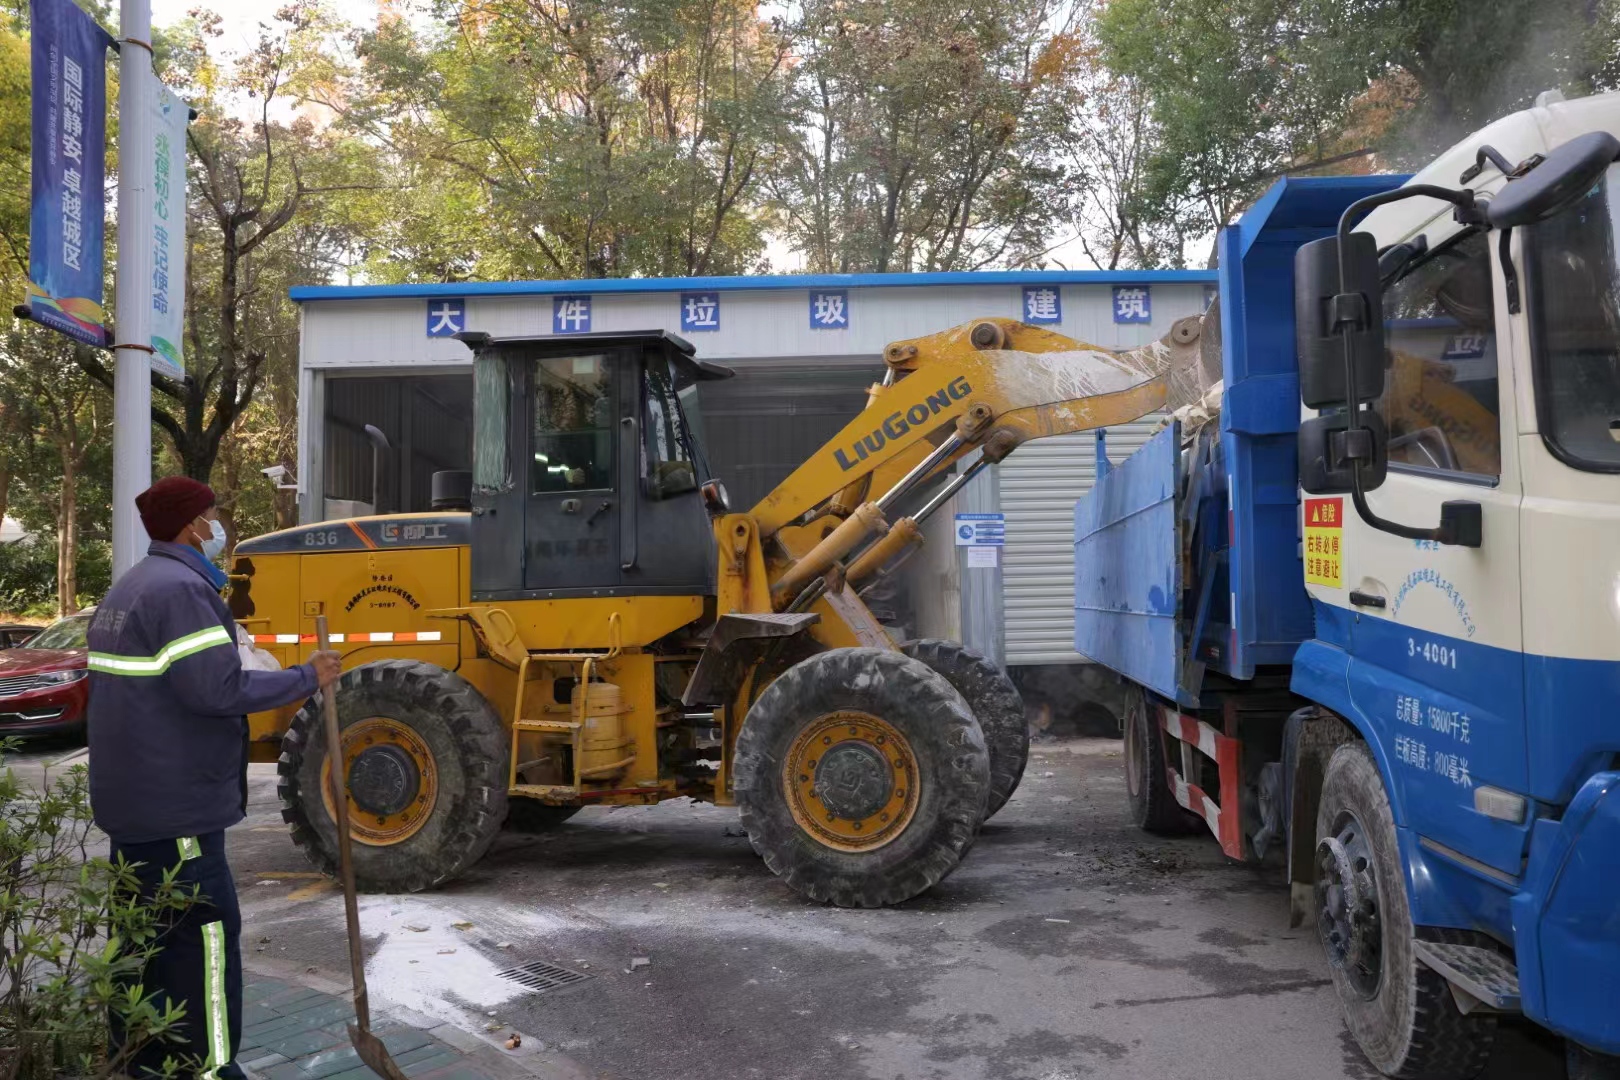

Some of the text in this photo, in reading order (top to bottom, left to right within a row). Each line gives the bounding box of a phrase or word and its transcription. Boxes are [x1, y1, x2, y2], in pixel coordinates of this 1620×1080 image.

[62, 55, 83, 271] 国际静安 卓越城区
[1321, 503, 1335, 523] 危险
[304, 531, 338, 546] 836
[1308, 535, 1339, 555] 右转必停
[1308, 557, 1339, 579] 注意避让
[1408, 638, 1457, 669] 3-4001
